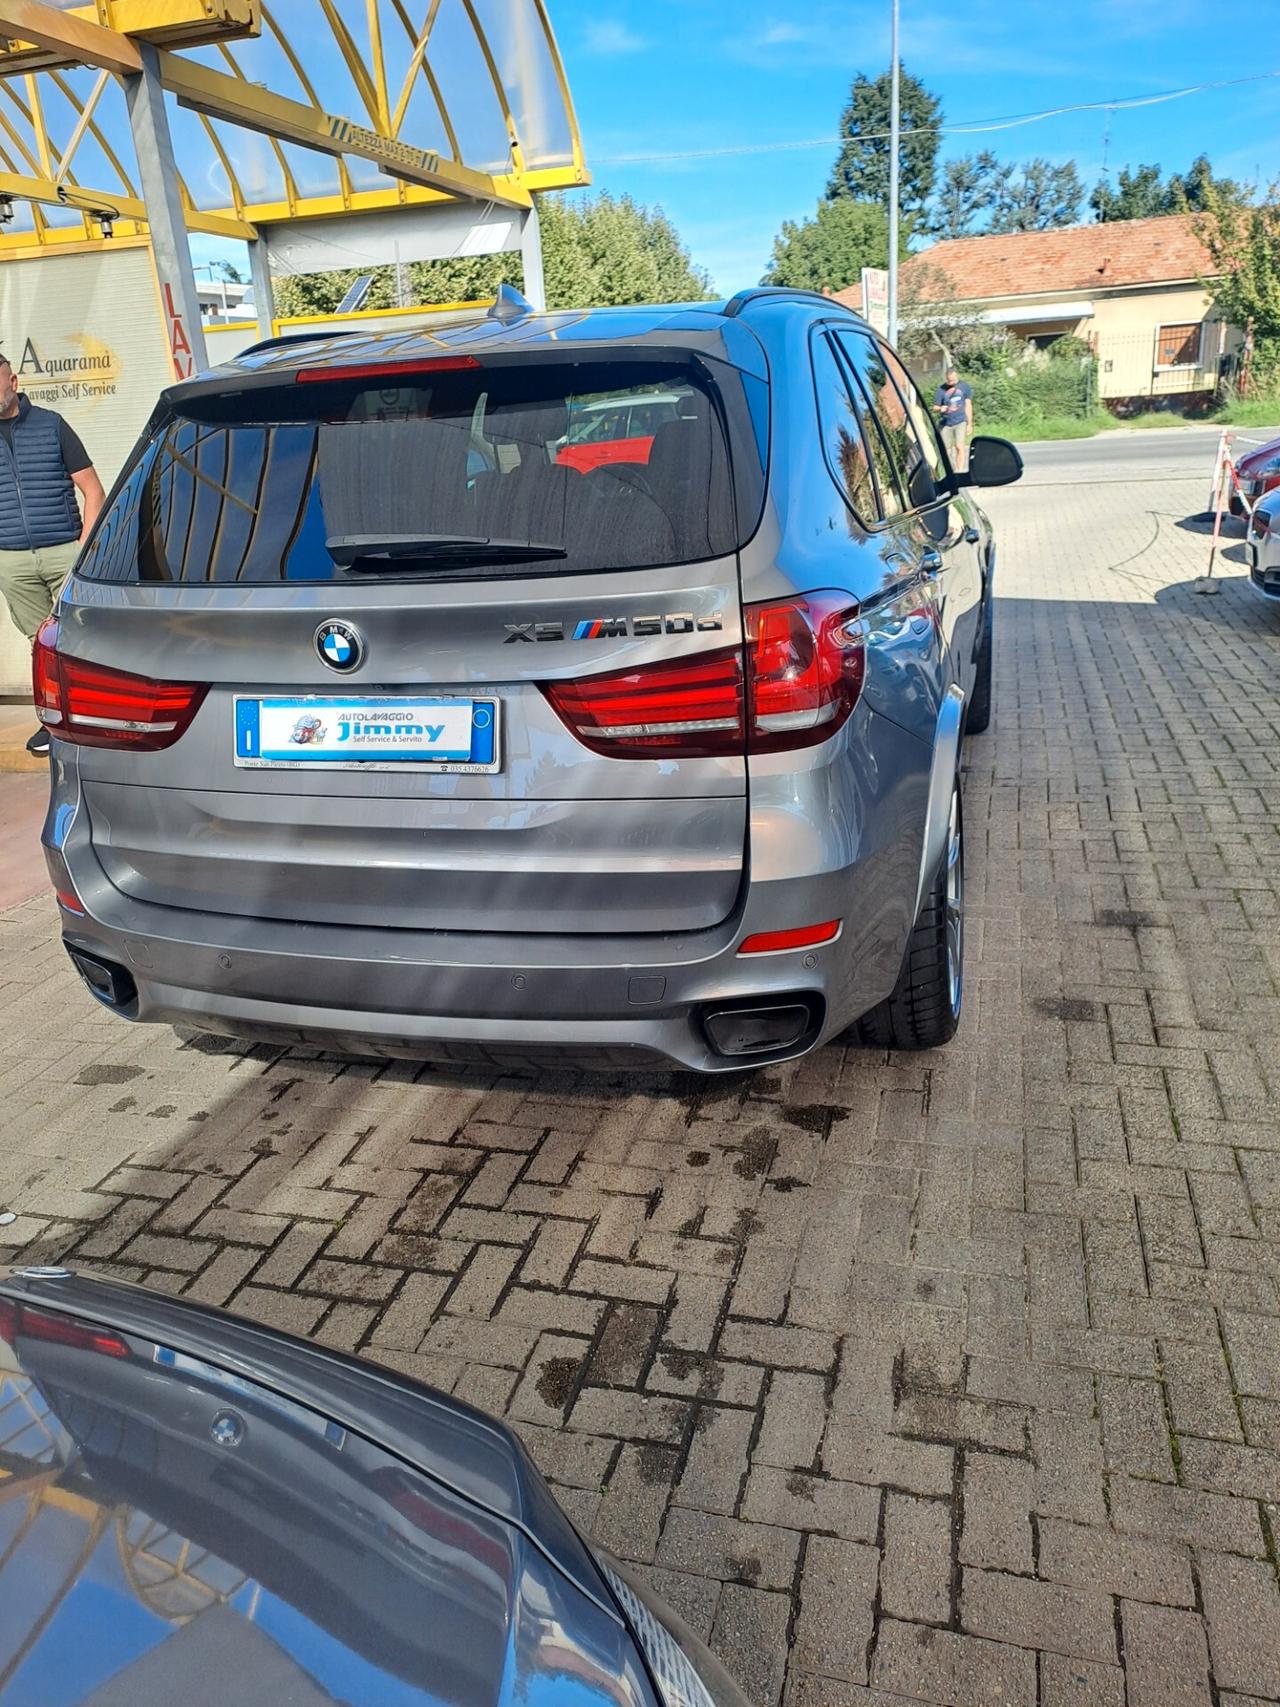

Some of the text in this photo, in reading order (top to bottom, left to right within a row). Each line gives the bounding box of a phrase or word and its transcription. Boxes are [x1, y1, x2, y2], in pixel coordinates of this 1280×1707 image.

[62, 384, 80, 399] Self
[82, 382, 116, 396] Service
[319, 626, 353, 640] BMW
[503, 622, 565, 643] X5
[337, 712, 414, 721] AUTOLAVAGGIO
[336, 722, 446, 742] Jimmy
[353, 735, 365, 743] Self
[367, 735, 391, 743] Service
[399, 735, 422, 743] Servito
